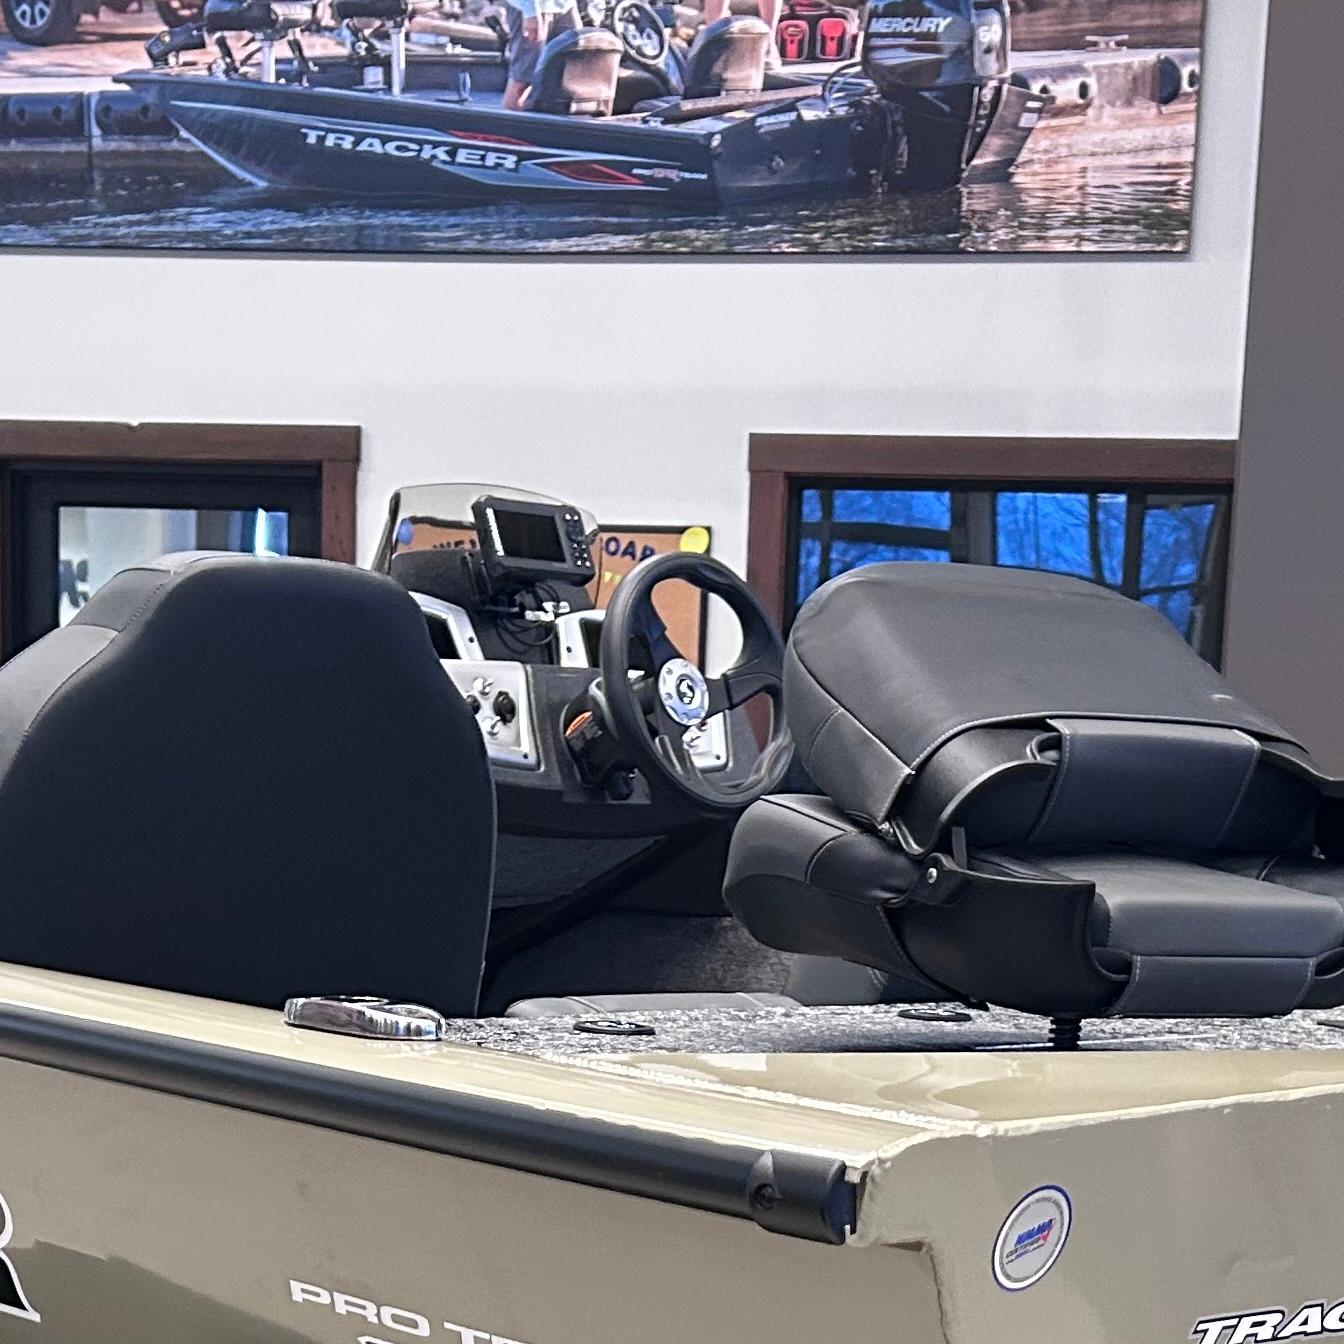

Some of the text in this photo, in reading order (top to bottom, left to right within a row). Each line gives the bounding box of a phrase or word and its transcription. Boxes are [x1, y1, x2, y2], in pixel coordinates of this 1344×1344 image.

[868, 16, 953, 33] MERCURY
[300, 127, 519, 170] TRACKER
[289, 1279, 431, 1337] PRO
